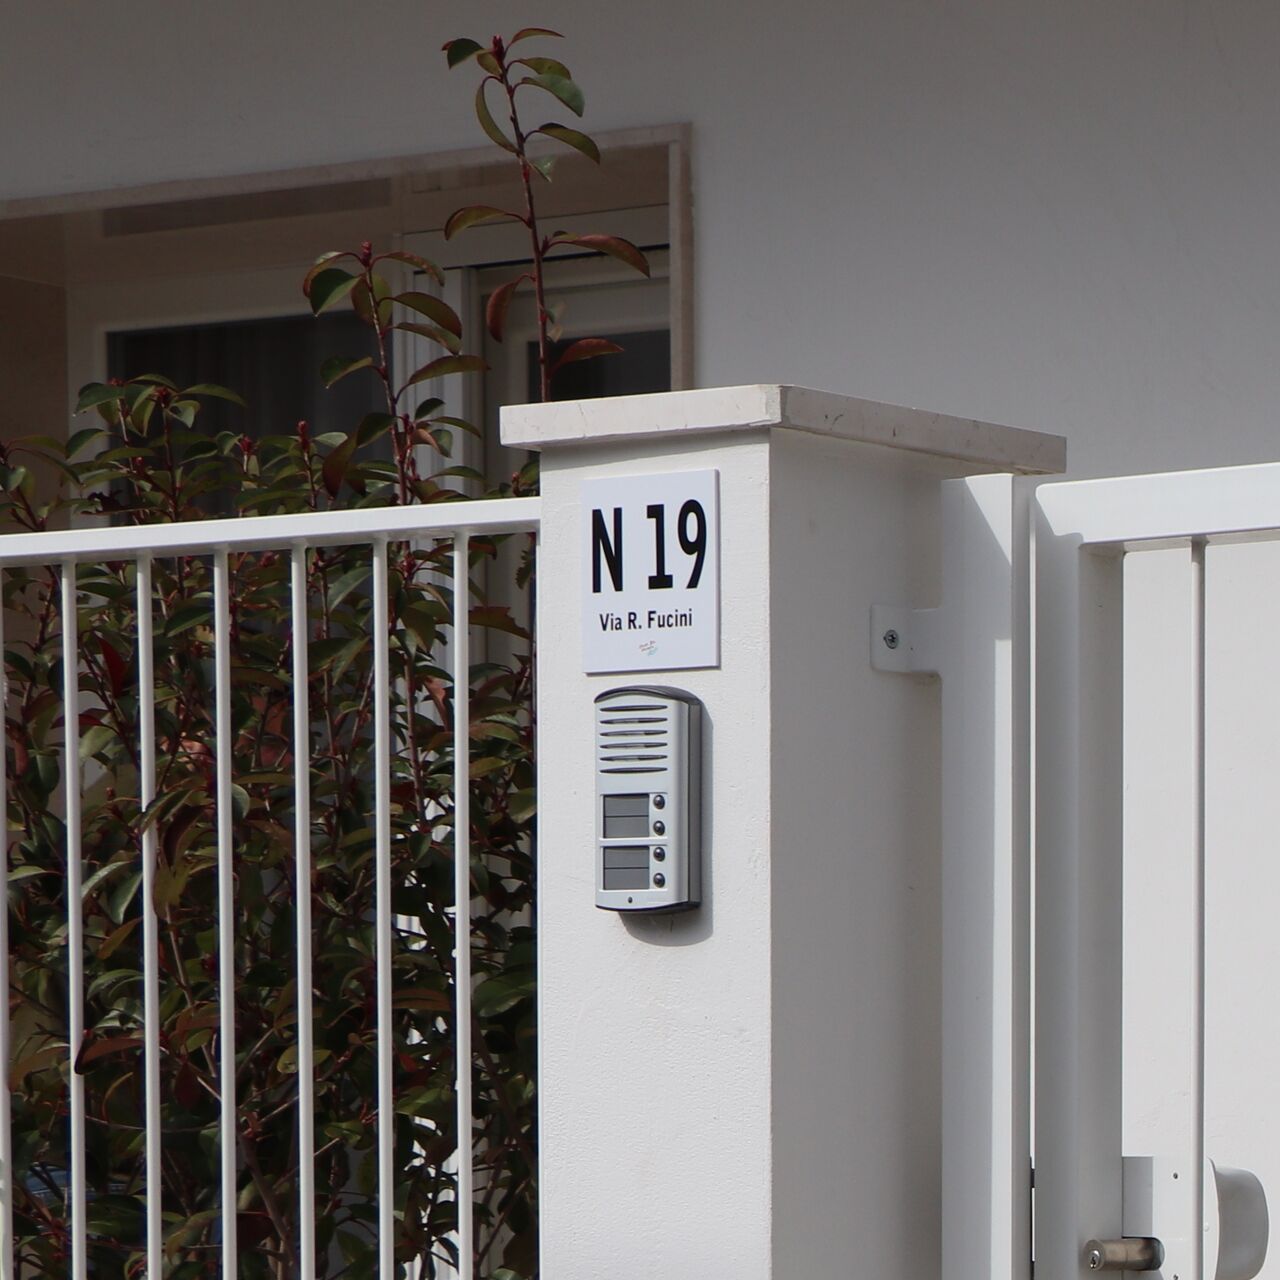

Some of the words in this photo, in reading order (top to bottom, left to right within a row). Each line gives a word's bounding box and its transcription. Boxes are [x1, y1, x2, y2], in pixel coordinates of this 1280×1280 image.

[592, 506, 624, 594] N
[646, 499, 707, 590] 19
[599, 612, 622, 632] Via
[628, 611, 642, 629] R.
[647, 608, 692, 629] Fucini
